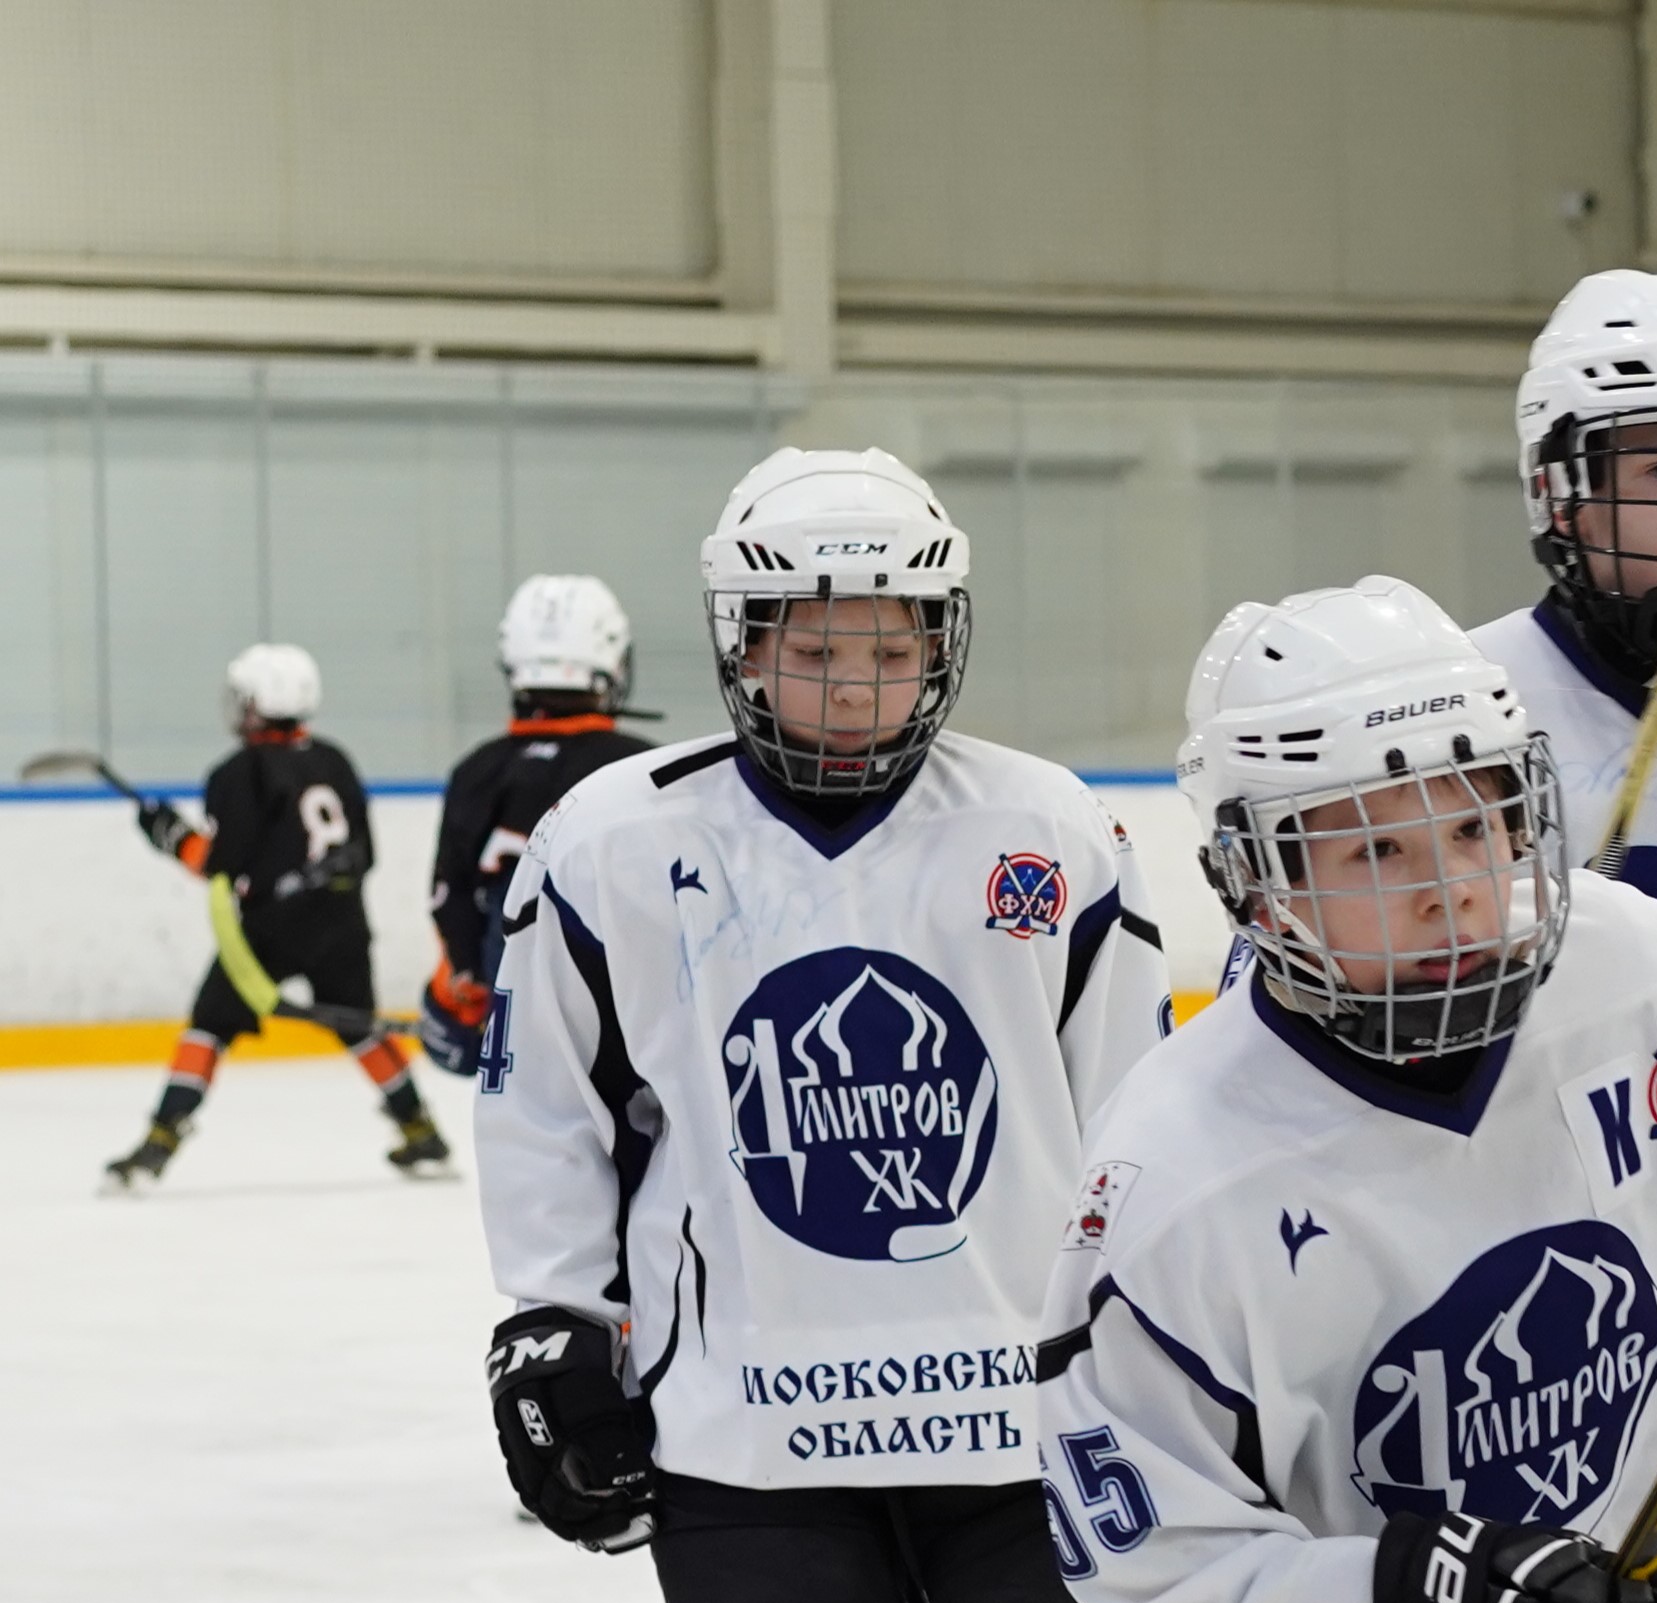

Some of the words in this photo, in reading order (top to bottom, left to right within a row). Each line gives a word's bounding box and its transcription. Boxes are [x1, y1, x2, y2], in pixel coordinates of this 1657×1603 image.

[816, 543, 888, 557] CCM
[1364, 693, 1467, 728] BAUER
[997, 892, 1055, 920] ФХМ
[850, 1147, 943, 1213] ХК
[485, 1330, 572, 1388] CM
[742, 1344, 1039, 1406] МОСКОВСКА
[787, 1410, 1022, 1461] ОБЛАСТЬ
[1515, 1427, 1600, 1525] ХК
